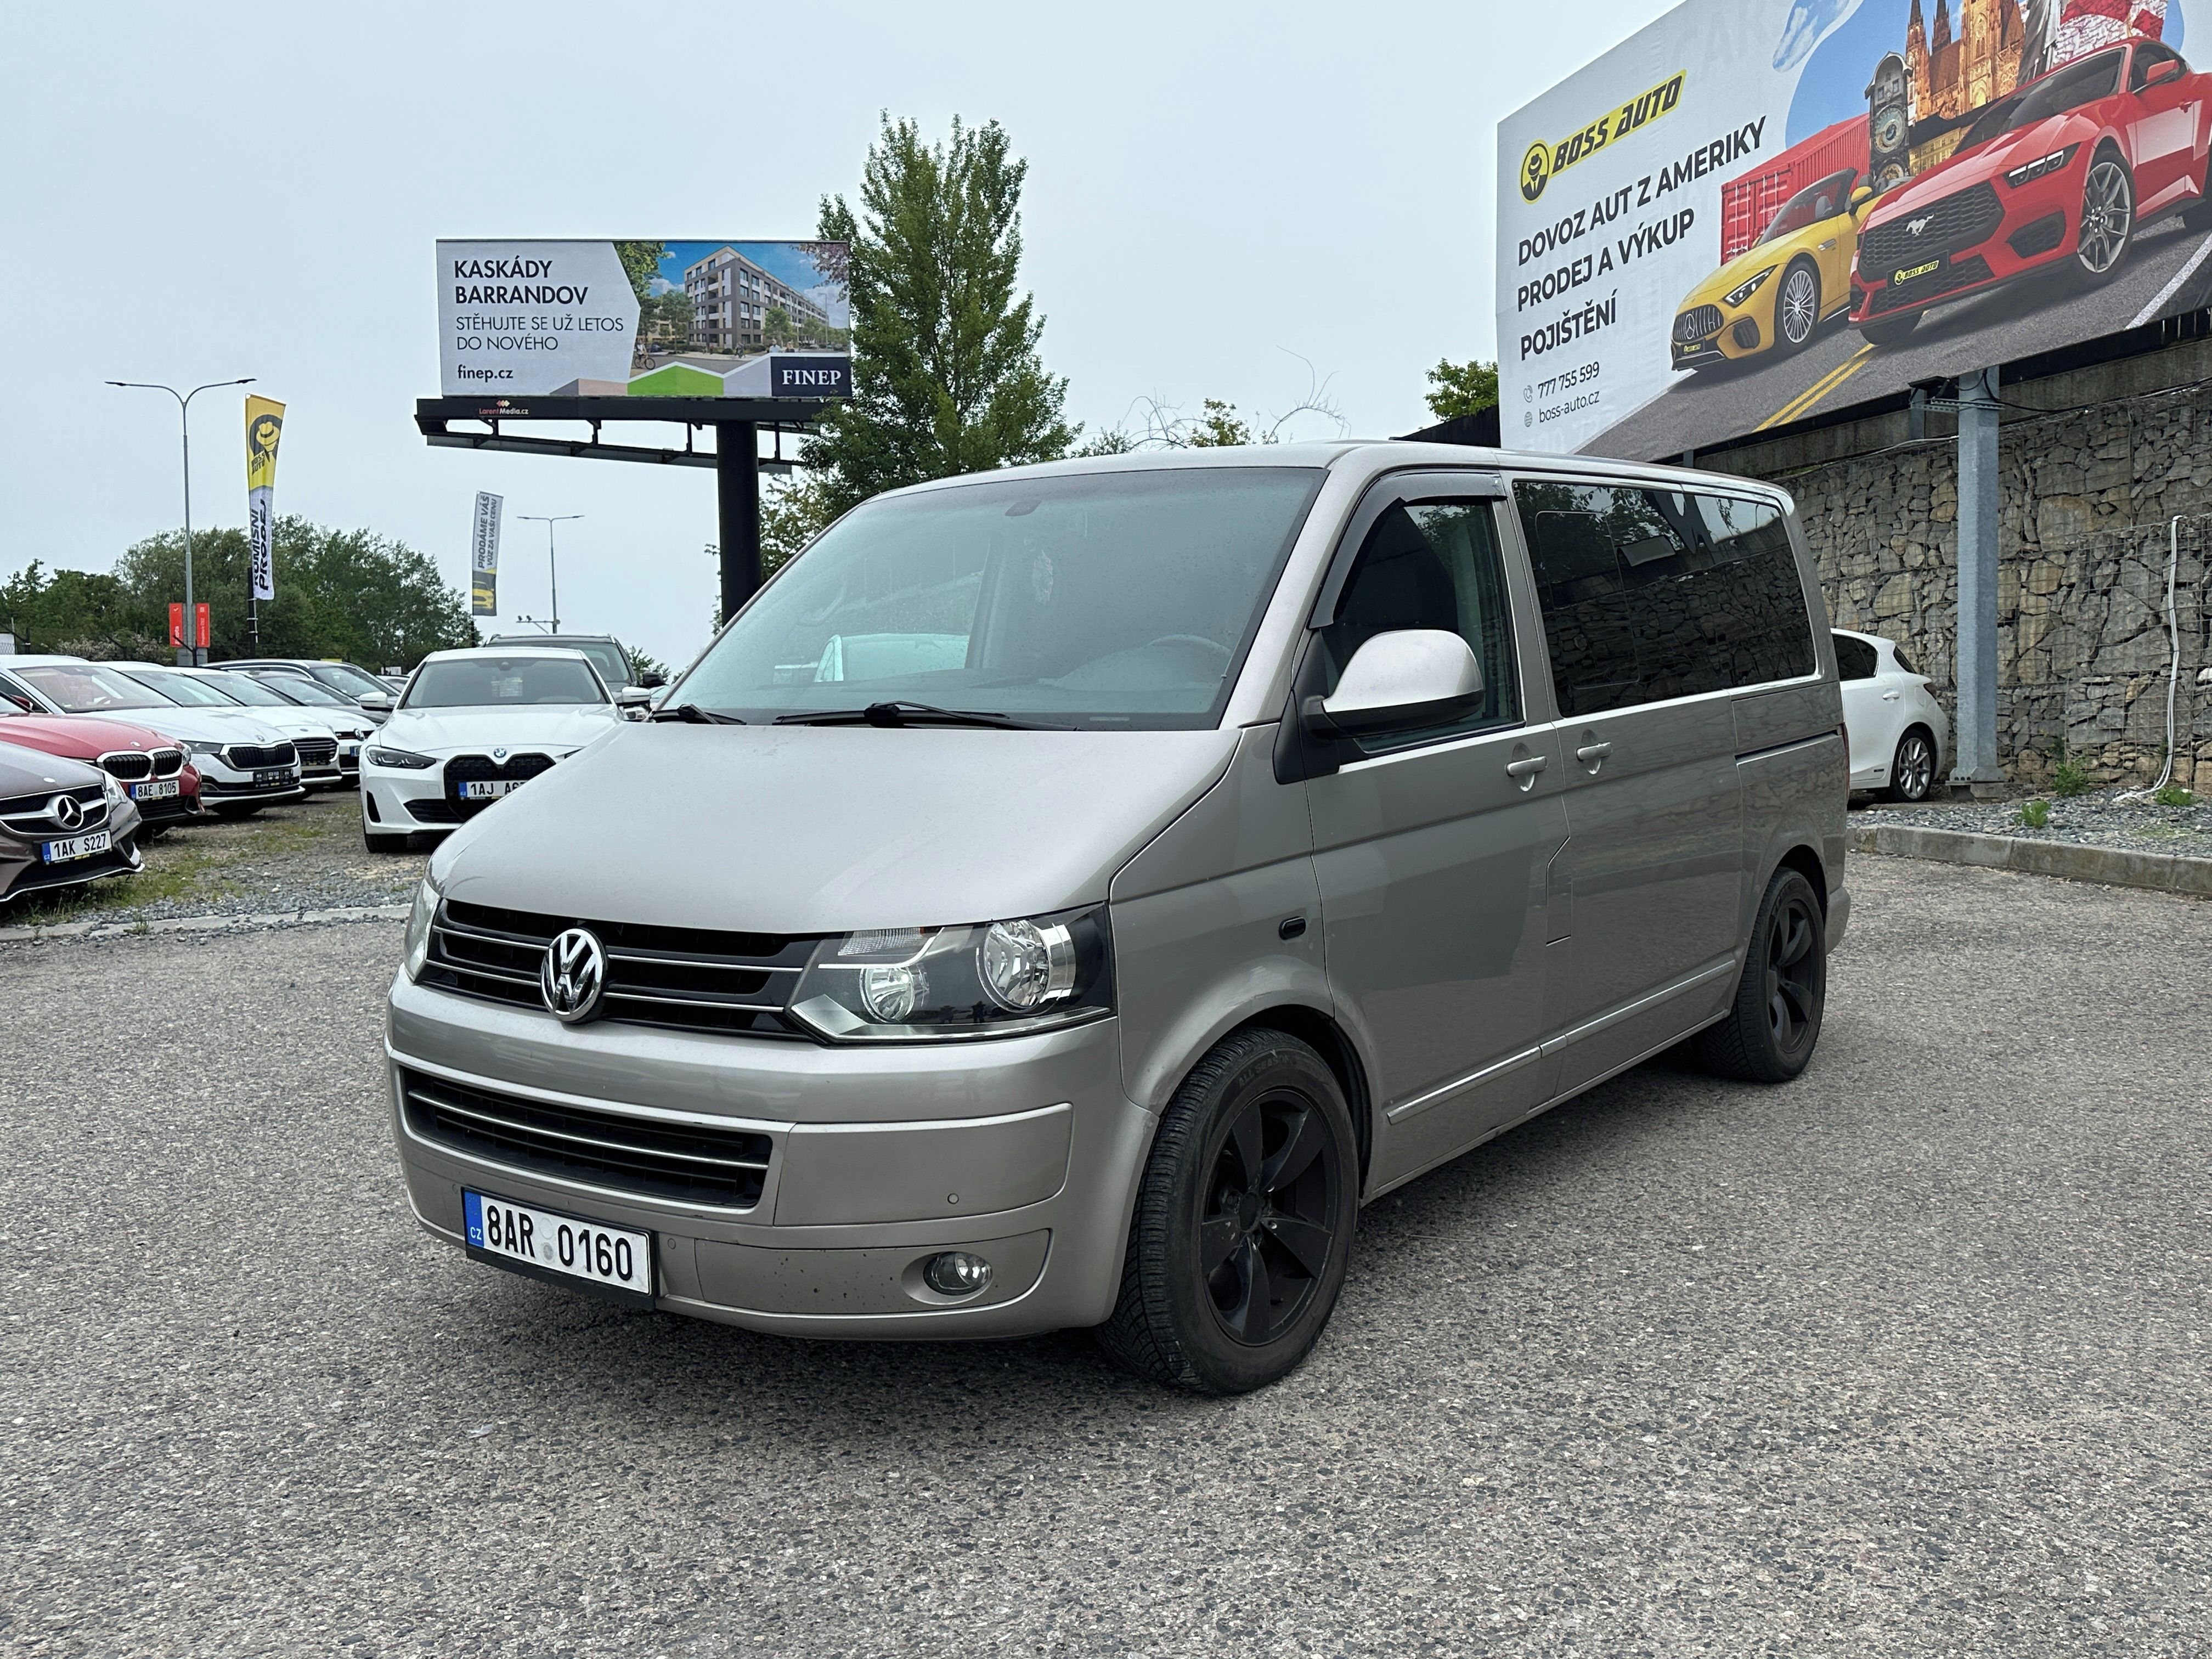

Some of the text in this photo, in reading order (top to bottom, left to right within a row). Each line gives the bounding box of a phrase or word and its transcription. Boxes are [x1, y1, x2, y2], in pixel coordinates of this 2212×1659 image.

[1551, 75, 1683, 174] BOSS AUTO
[1519, 115, 1767, 266] DOVOZ AUT Z AMERIKY
[454, 255, 552, 278] KASKÁDY
[1518, 208, 1695, 312] PRODEJ A VÝKUP
[455, 285, 588, 305] BARRANDOV
[456, 313, 624, 331] STĚHUJTE SE UŽ LETOS
[1521, 288, 1618, 361] POJIŠTĚNÍ
[457, 333, 558, 350] DO NOVÉHO
[458, 364, 514, 383] finep.cz
[782, 369, 842, 385] FINEP
[1538, 361, 1599, 398] 777 755 599
[1539, 391, 1600, 423] boss-auto.cz
[476, 495, 489, 569] PRODÁME VÁŠ
[259, 498, 269, 591] PRODEJ
[488, 539, 494, 549] ZA
[138, 782, 176, 797] 8AE 8105
[471, 782, 527, 795] 1AJ A6
[54, 833, 106, 857] 1AK S227
[470, 1227, 482, 1241] CZ
[487, 1205, 633, 1281] 8AR 0160
